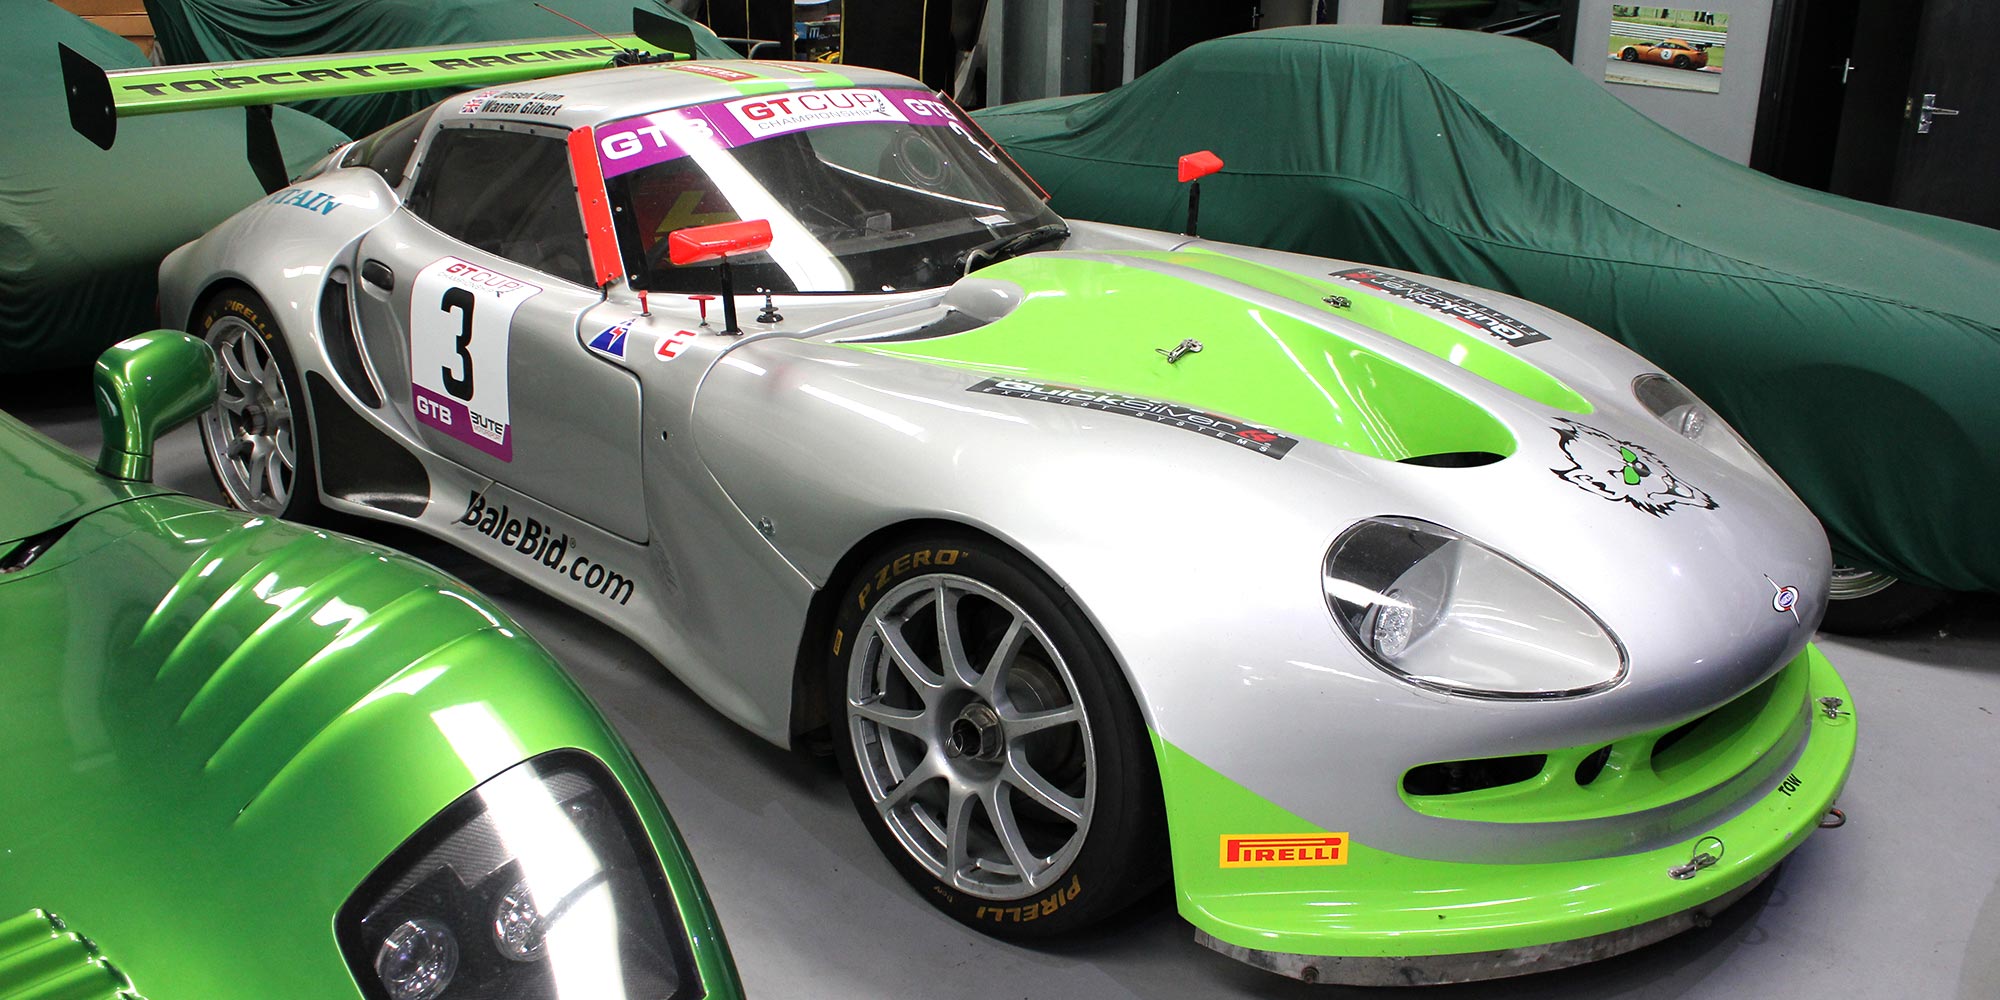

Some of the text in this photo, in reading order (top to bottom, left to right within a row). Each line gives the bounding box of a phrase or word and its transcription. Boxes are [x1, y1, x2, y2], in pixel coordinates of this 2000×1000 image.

[123, 46, 619, 97] TOPCATS RACING
[481, 99, 562, 116] Warren Gilbert
[741, 93, 875, 121] GT CUP
[758, 109, 872, 130] CHAMPIONSHIP
[903, 98, 959, 122] GTB
[948, 120, 998, 164] 3
[446, 263, 520, 289] GT CUP
[441, 286, 476, 402] 3
[416, 395, 452, 426] GTB
[1777, 772, 1802, 797] TOW
[1227, 837, 1341, 862] PIRELLI
[976, 874, 1082, 923] PIRELLI
